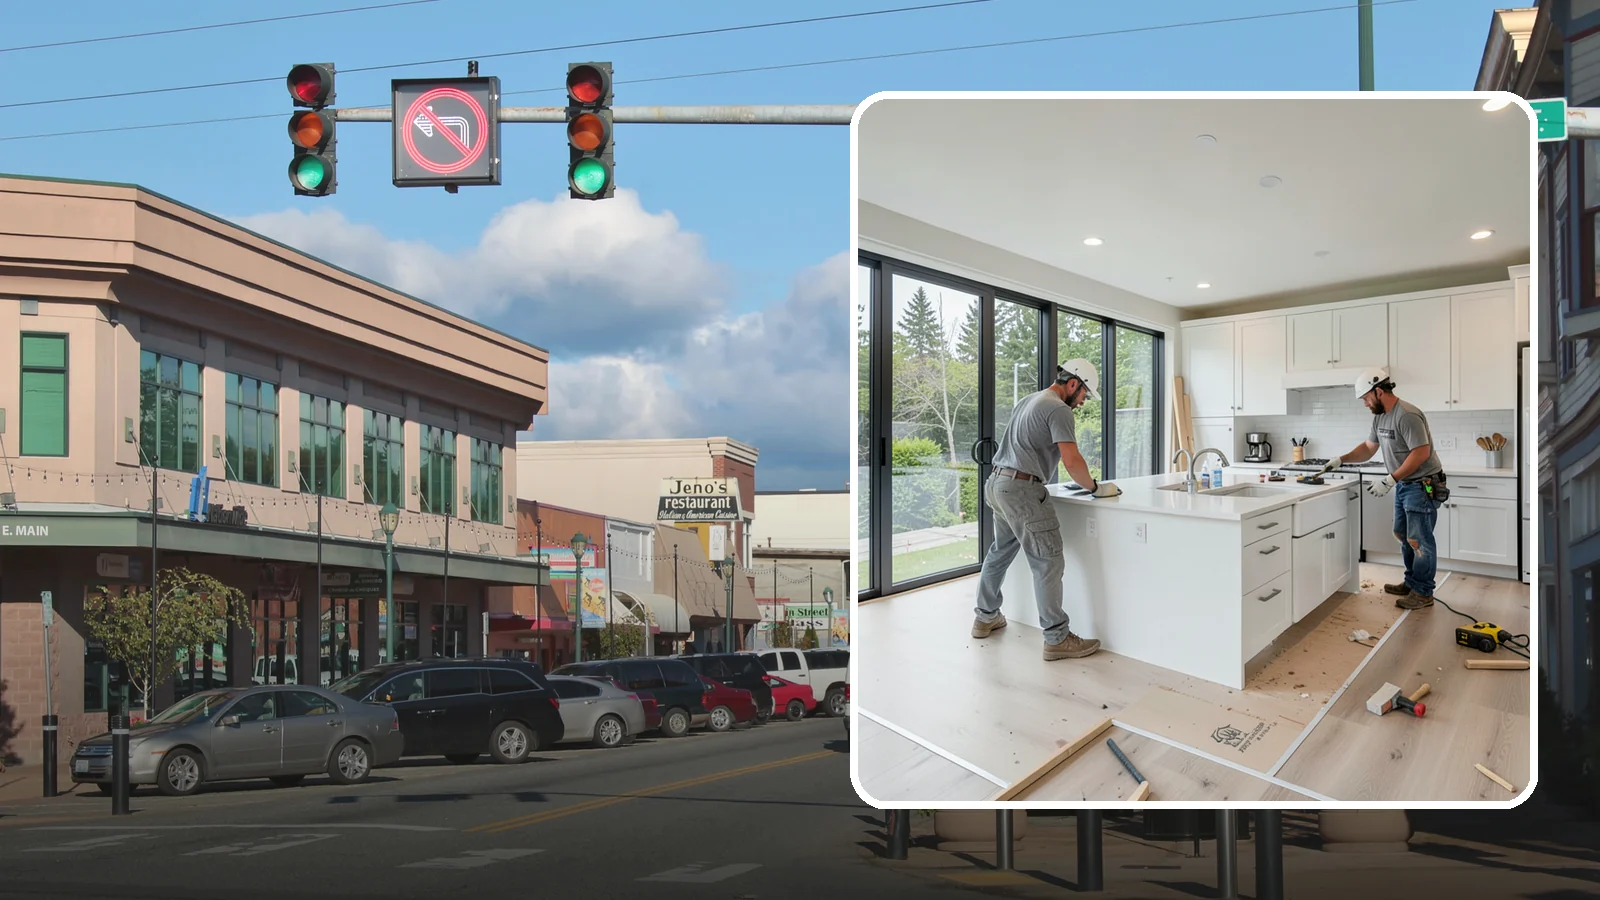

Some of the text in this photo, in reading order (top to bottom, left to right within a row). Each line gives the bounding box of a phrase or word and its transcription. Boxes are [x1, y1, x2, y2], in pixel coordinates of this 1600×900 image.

[670, 480, 727, 494] Jeno's
[665, 496, 731, 509] restaurant
[659, 510, 681, 519] Italian
[686, 510, 714, 519] American
[715, 510, 737, 519] Cuisine
[2, 525, 49, 536] E. MAIN
[797, 607, 828, 617] Street
